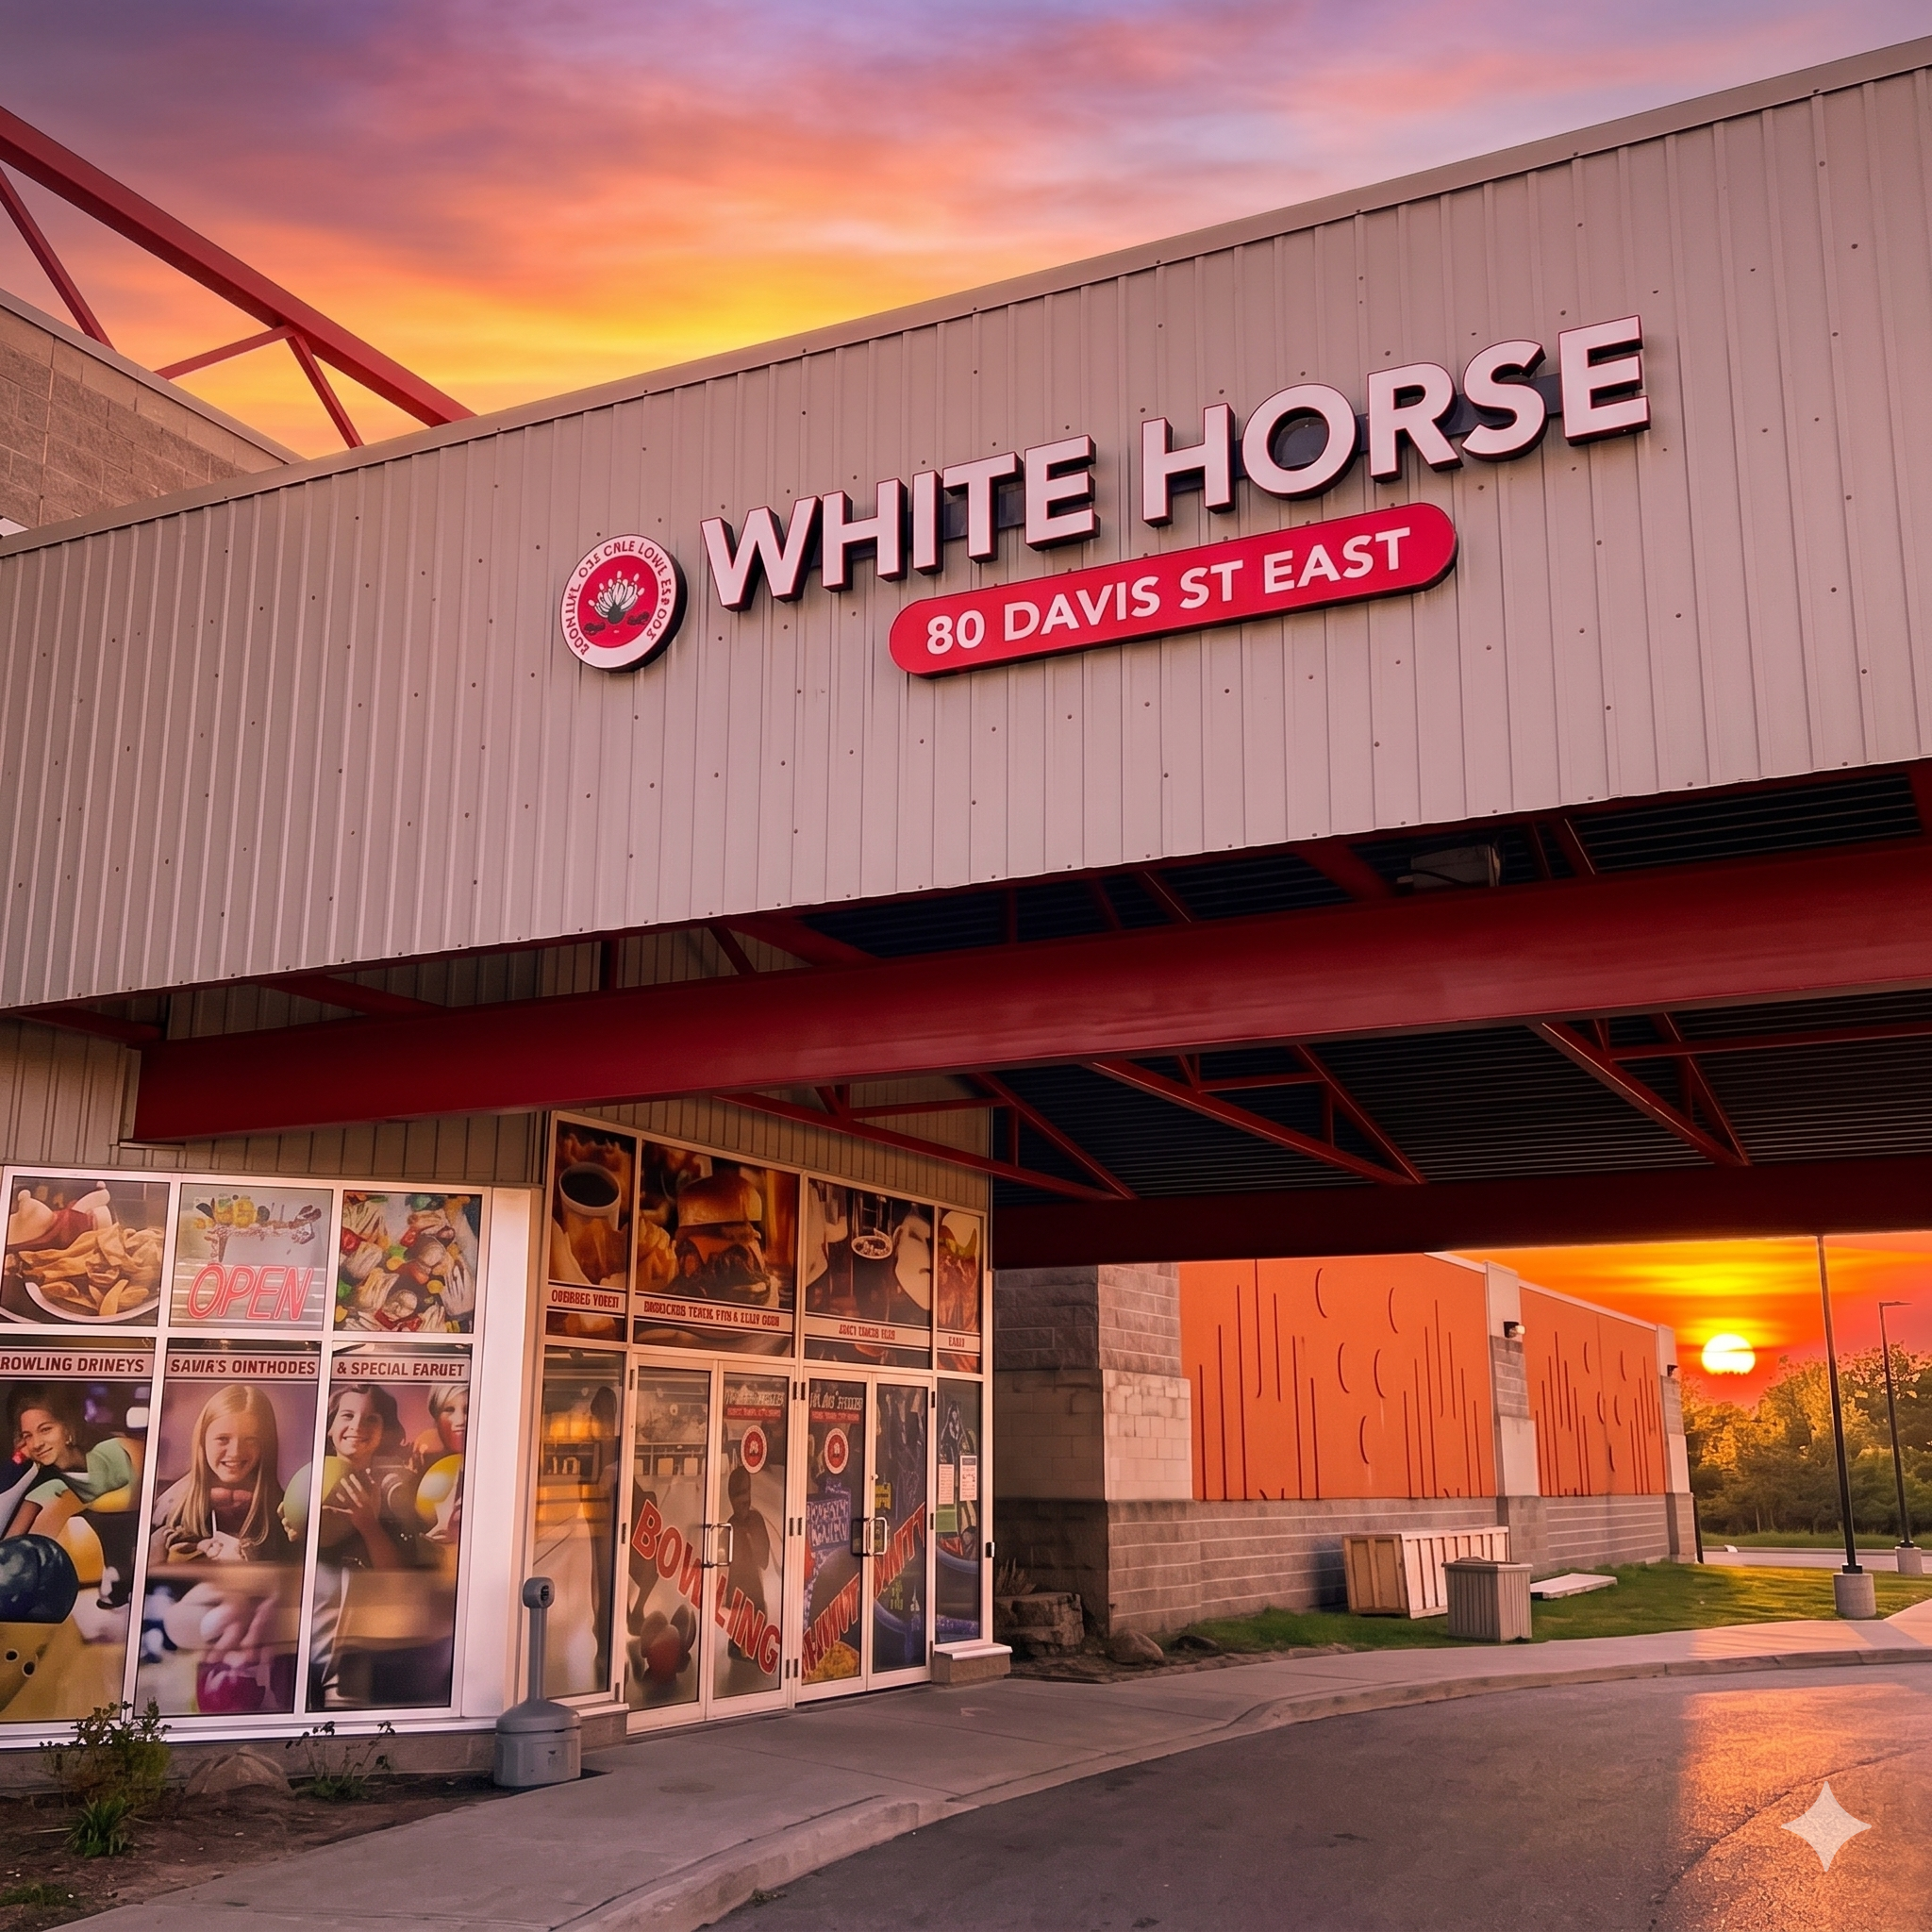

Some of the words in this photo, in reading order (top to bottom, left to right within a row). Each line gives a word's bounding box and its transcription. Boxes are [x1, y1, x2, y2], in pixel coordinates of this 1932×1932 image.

[701, 435, 1095, 608] WHITE
[1142, 315, 1649, 525] HORSE
[925, 613, 985, 656] 80
[1003, 574, 1160, 642] DAVIS
[1179, 560, 1243, 611] ST
[1263, 526, 1411, 592] EAST
[188, 1263, 314, 1320] OPEN
[77, 1357, 144, 1373] DRINEYS
[232, 1360, 316, 1374] OINTHODES
[337, 1362, 346, 1374] &
[351, 1362, 408, 1375] SPECIAL
[632, 1499, 781, 1674] BOWLING
